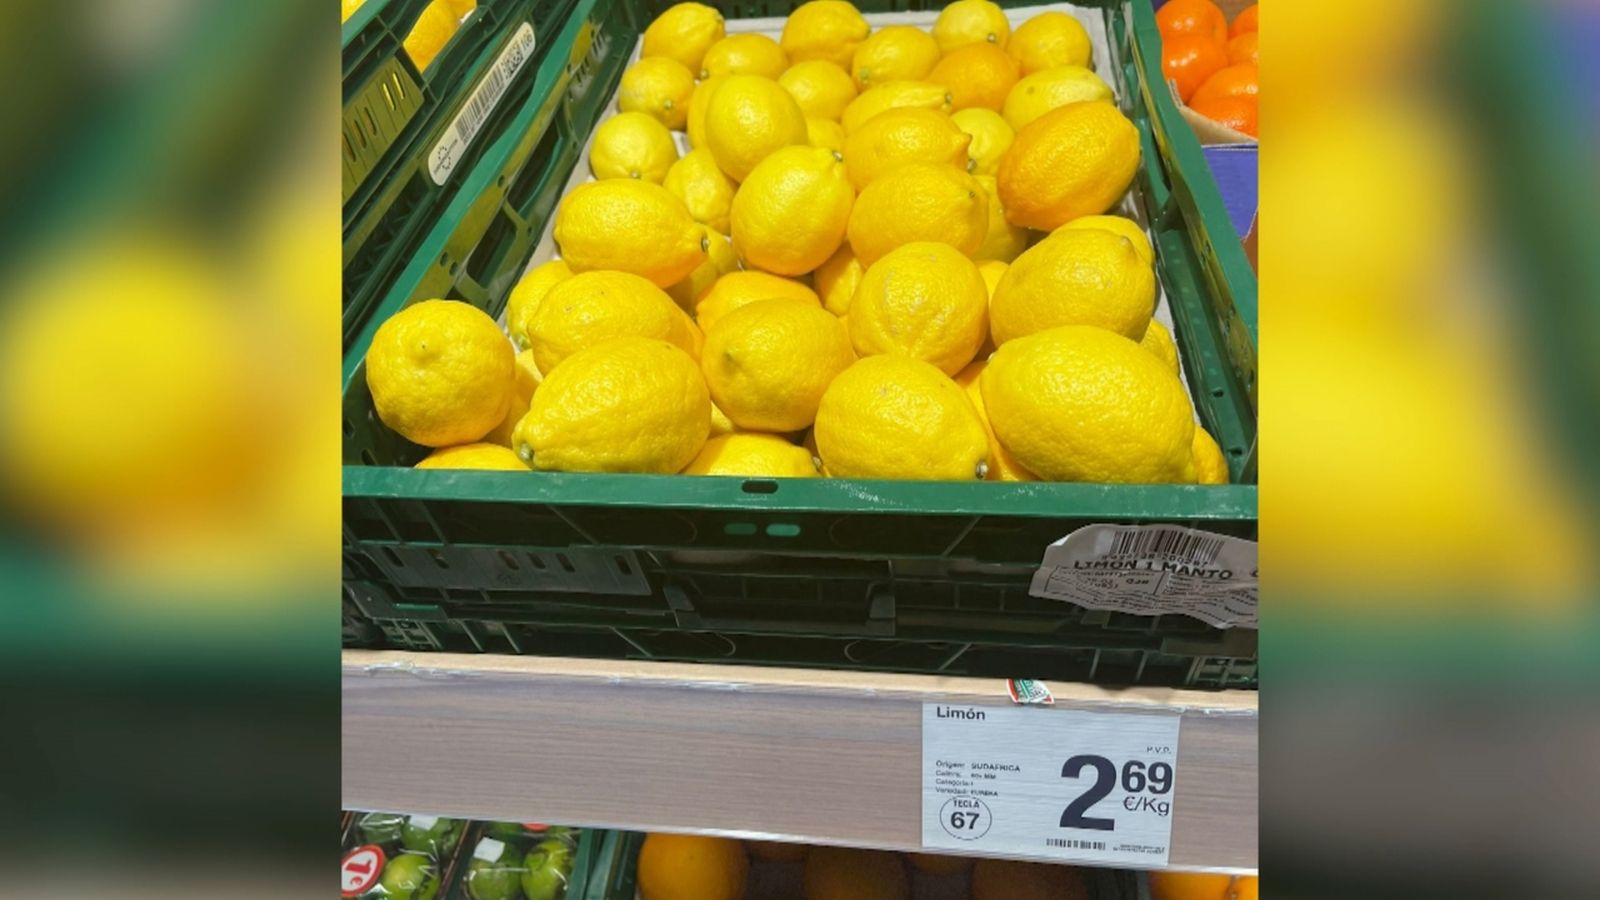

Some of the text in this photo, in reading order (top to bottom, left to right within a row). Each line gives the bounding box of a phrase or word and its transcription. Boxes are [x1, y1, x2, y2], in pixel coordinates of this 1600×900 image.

[1146, 560, 1153, 570] 1
[1162, 562, 1233, 579] MANTO
[936, 706, 986, 721] Limón
[1146, 746, 1172, 755] P.V.P.
[970, 762, 1021, 772] SUDAFRICA
[1059, 753, 1173, 832] 2 69
[953, 799, 980, 809] TECLA
[1123, 796, 1170, 817] €/Kg
[950, 811, 980, 830] 67
